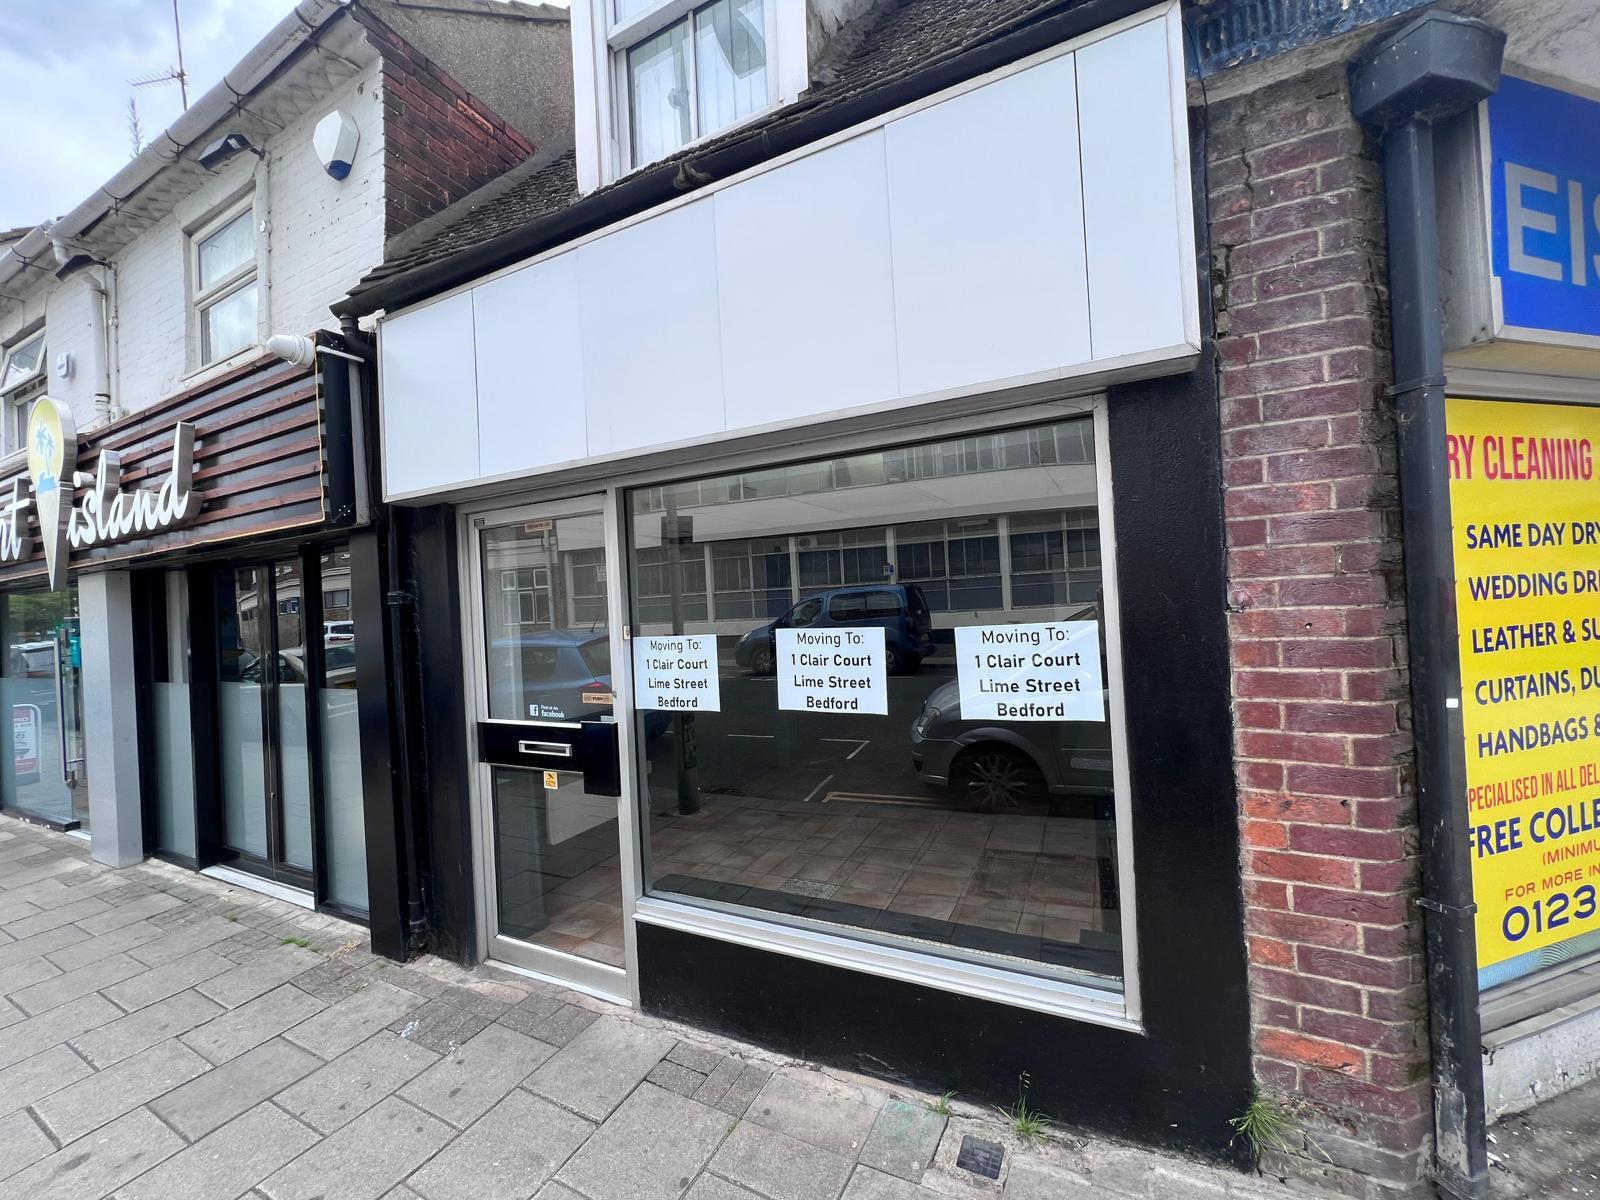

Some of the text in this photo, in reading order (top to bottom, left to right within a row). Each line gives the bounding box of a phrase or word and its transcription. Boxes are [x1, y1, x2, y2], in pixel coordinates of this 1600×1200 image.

[1504, 161, 1600, 286] EI
[1483, 435, 1592, 481] CLEANING
[66, 421, 189, 547] island
[1466, 524, 1523, 549] SAME
[1527, 523, 1566, 547] DAY
[1468, 570, 1600, 601] WEDDING DR
[797, 631, 864, 648] Moving To:
[981, 627, 1070, 646] Moving To:
[1472, 622, 1558, 654] LEATHER
[1563, 620, 1576, 644] &
[650, 639, 702, 653] Moving To:
[646, 659, 708, 669] 1 Clair Court
[791, 654, 872, 666] 1 Clair Court
[975, 653, 1081, 668] 1 Clair Court
[648, 678, 708, 689] Lime Street
[794, 675, 871, 688] Lime Street
[979, 678, 1081, 693] Lime Street
[1475, 669, 1576, 705] CURTAINS,
[658, 696, 698, 708] Bedford
[806, 696, 858, 709] Bedford
[997, 702, 1065, 717] Bedford
[541, 709, 565, 718] facebook
[1478, 716, 1589, 758] HANDBAGS
[1469, 775, 1538, 812] PECIALISED
[1541, 772, 1553, 796] IN
[1557, 767, 1577, 794] ALL
[1505, 882, 1536, 901] FOR
[1542, 868, 1584, 890] MORE
[1502, 884, 1596, 942] 0123
